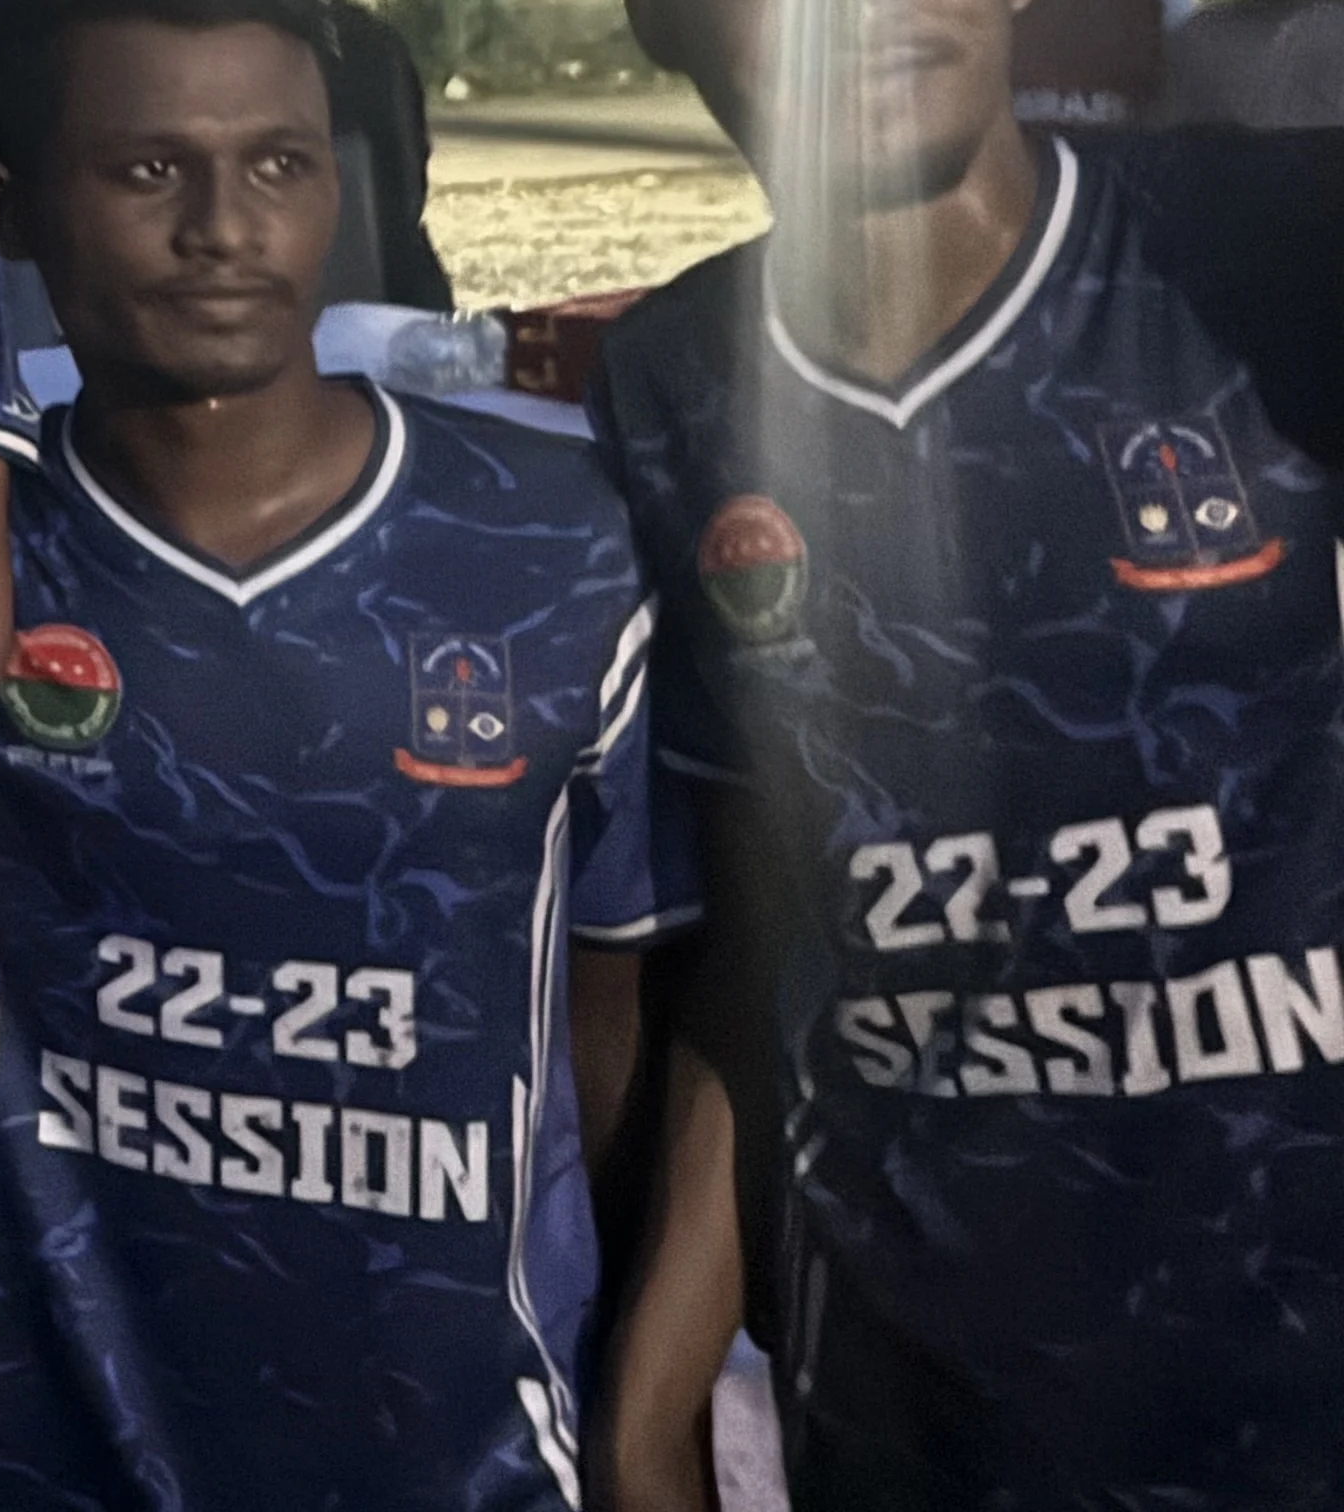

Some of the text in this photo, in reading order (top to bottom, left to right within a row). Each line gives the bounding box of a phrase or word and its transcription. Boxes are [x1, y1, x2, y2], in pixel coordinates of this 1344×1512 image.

[848, 804, 1233, 953] 22-23
[97, 934, 416, 1070] 22-23
[837, 946, 1344, 1098] SESSION
[37, 1049, 489, 1223] SESSION
